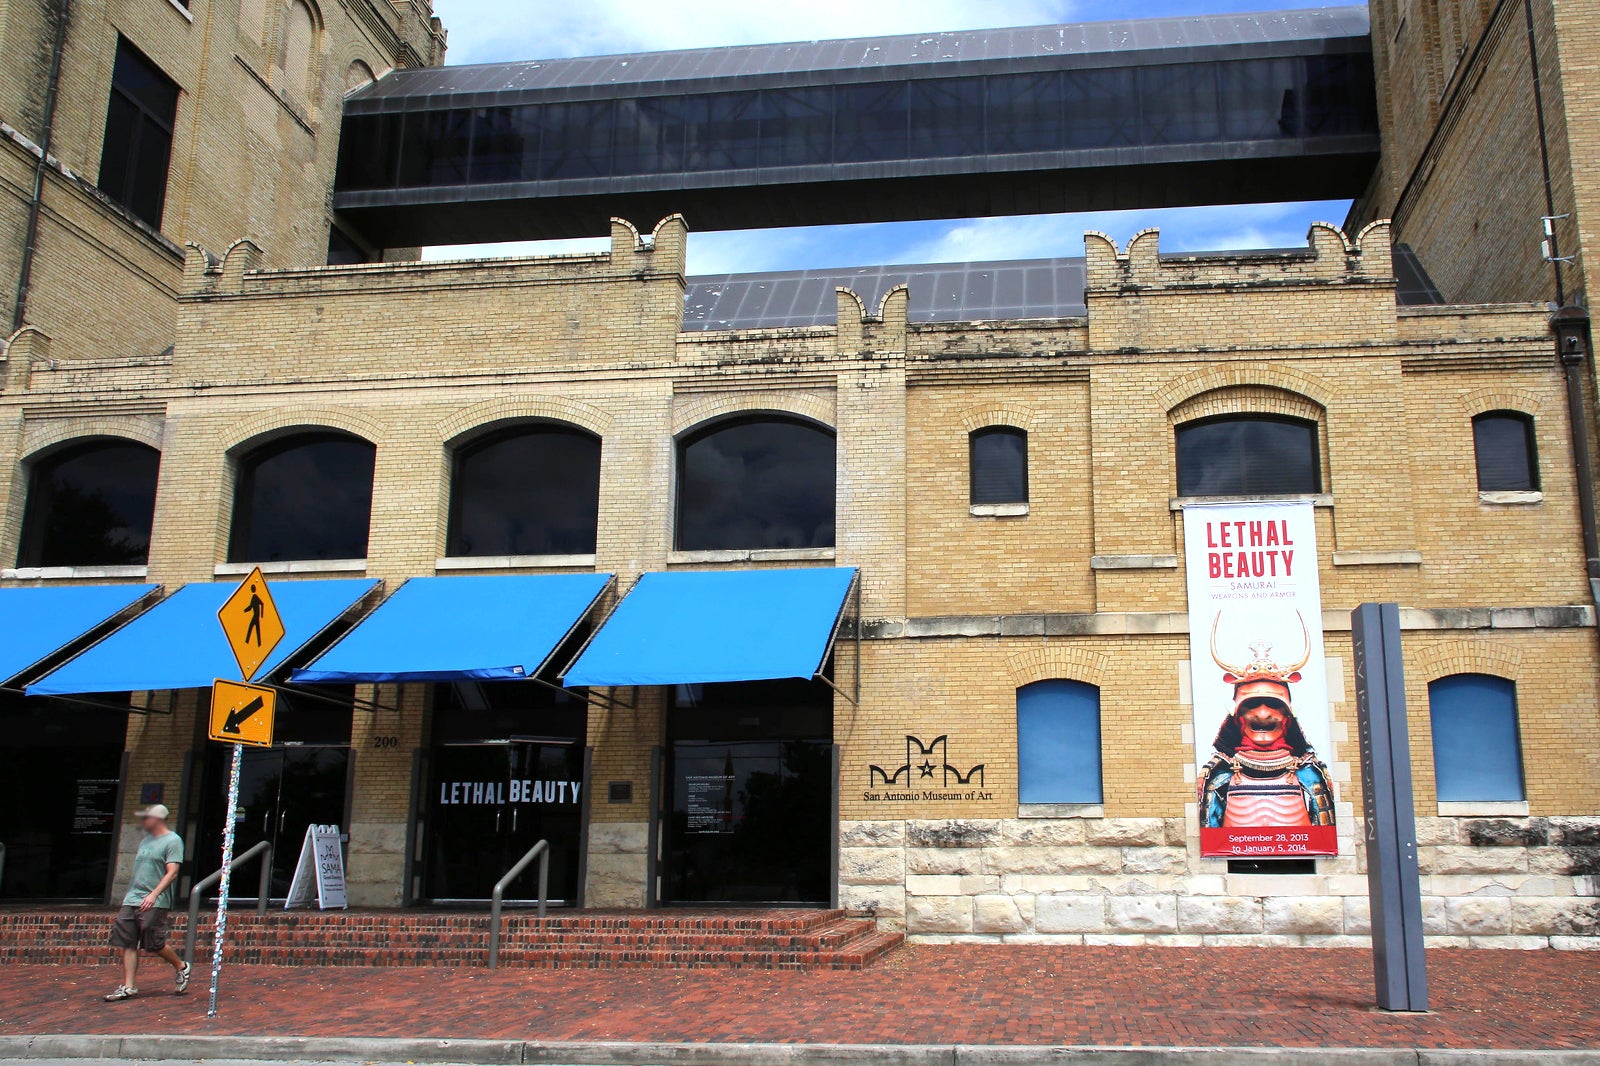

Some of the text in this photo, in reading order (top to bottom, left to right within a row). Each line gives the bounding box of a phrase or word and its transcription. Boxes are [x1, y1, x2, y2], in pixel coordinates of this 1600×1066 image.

[1206, 520, 1294, 548] LETHAL
[1208, 550, 1294, 579] BEAUTY
[1230, 581, 1276, 591] SAMURAI
[373, 736, 398, 749] 200
[440, 779, 582, 805] LETHAL BEAUTY
[863, 790, 993, 801] San Antonio Museum of Art
[1228, 833, 1309, 843] September 28, 2013
[1231, 845, 1241, 853] to
[1242, 844, 1276, 853] January
[1287, 844, 1307, 852] 2014
